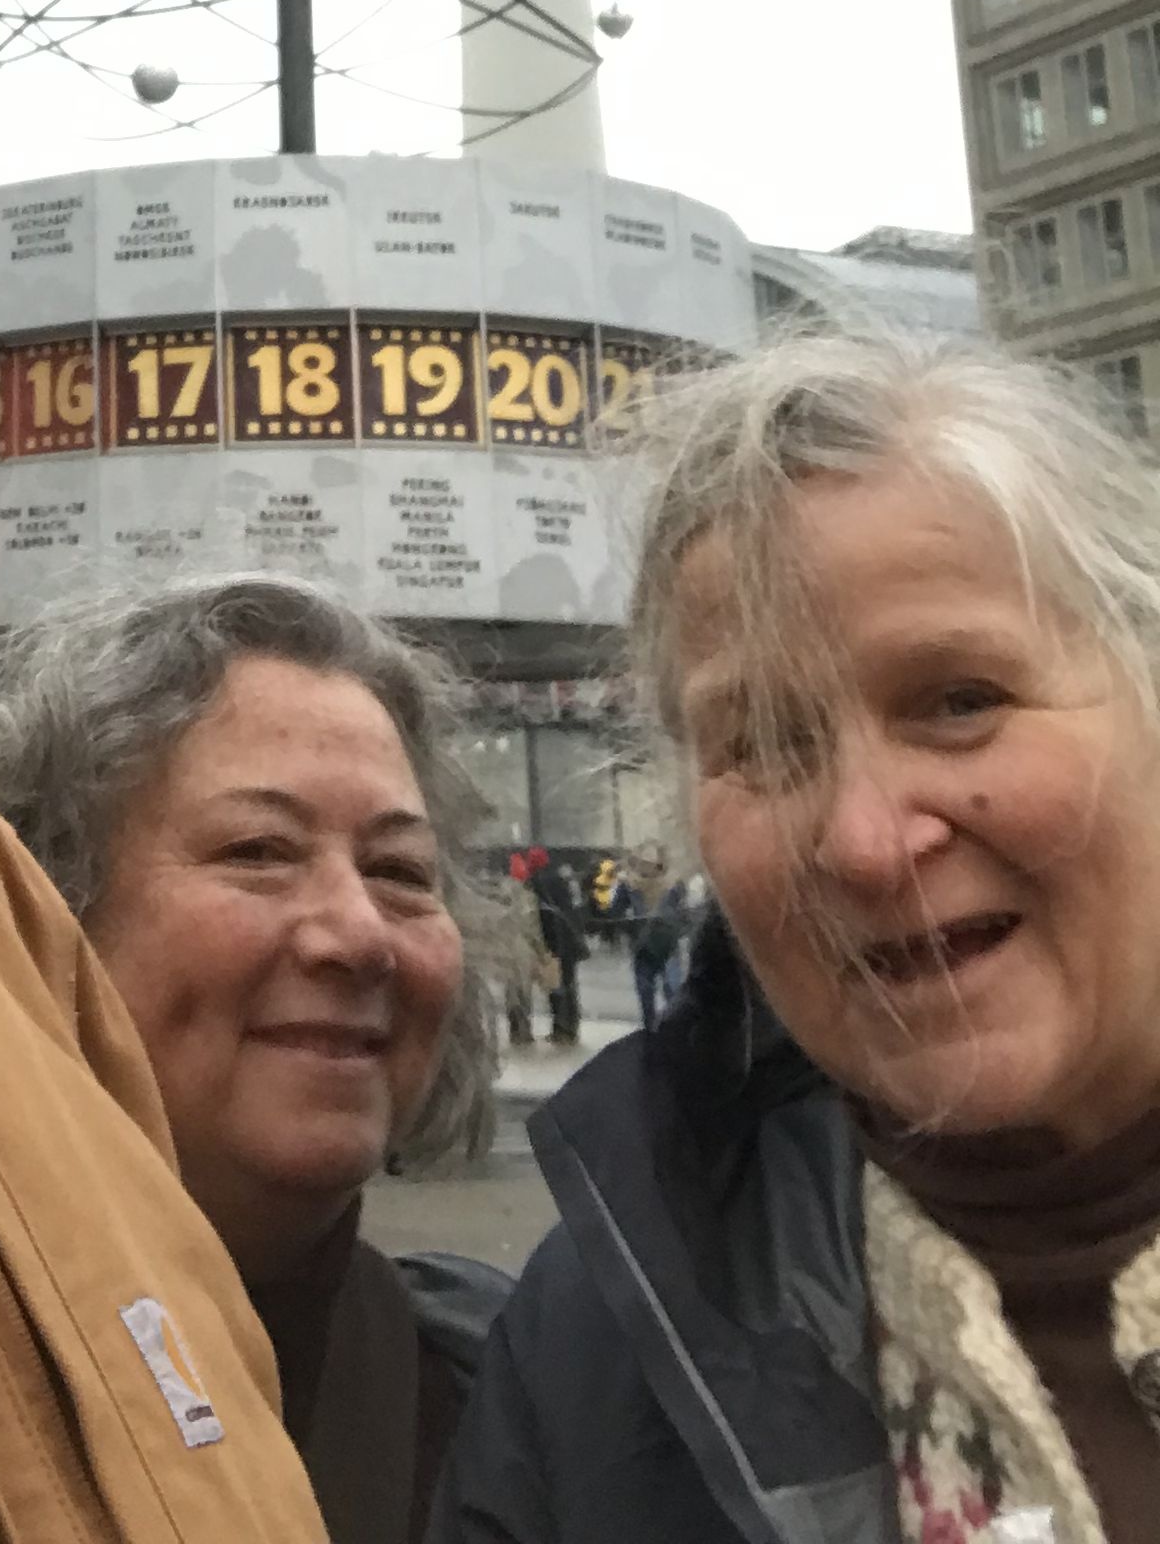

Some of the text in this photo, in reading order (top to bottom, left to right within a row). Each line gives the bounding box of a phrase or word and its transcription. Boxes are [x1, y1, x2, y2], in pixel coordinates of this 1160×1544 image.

[27, 355, 97, 426] 16
[127, 344, 215, 419] 17
[247, 342, 341, 417] 18
[370, 344, 464, 417] 19
[486, 348, 583, 427] 20
